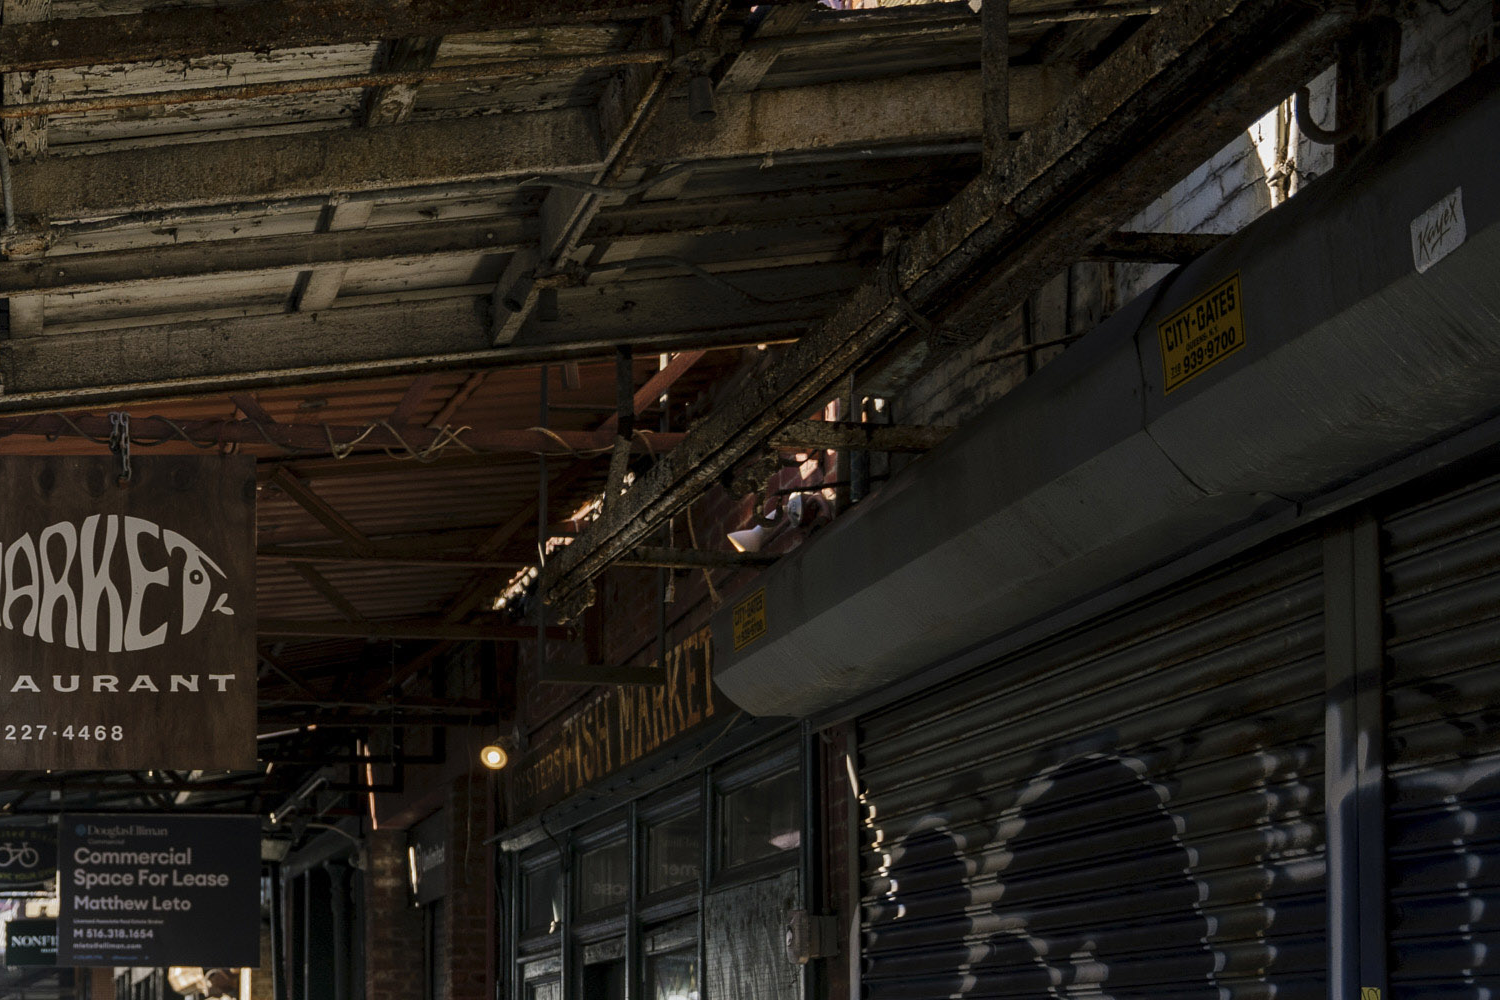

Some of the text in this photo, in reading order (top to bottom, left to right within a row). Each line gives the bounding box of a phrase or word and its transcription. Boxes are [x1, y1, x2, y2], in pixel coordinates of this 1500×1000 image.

[1165, 285, 1235, 351] CITY-GATES
[562, 691, 612, 794] FISH
[616, 624, 715, 767] MARKET
[74, 847, 192, 865] Commercial
[73, 869, 134, 890] Space
[138, 869, 169, 886] For
[172, 870, 229, 887] Lease
[74, 895, 192, 911] Matthew Leto
[73, 929, 154, 939] M 516.318.1654
